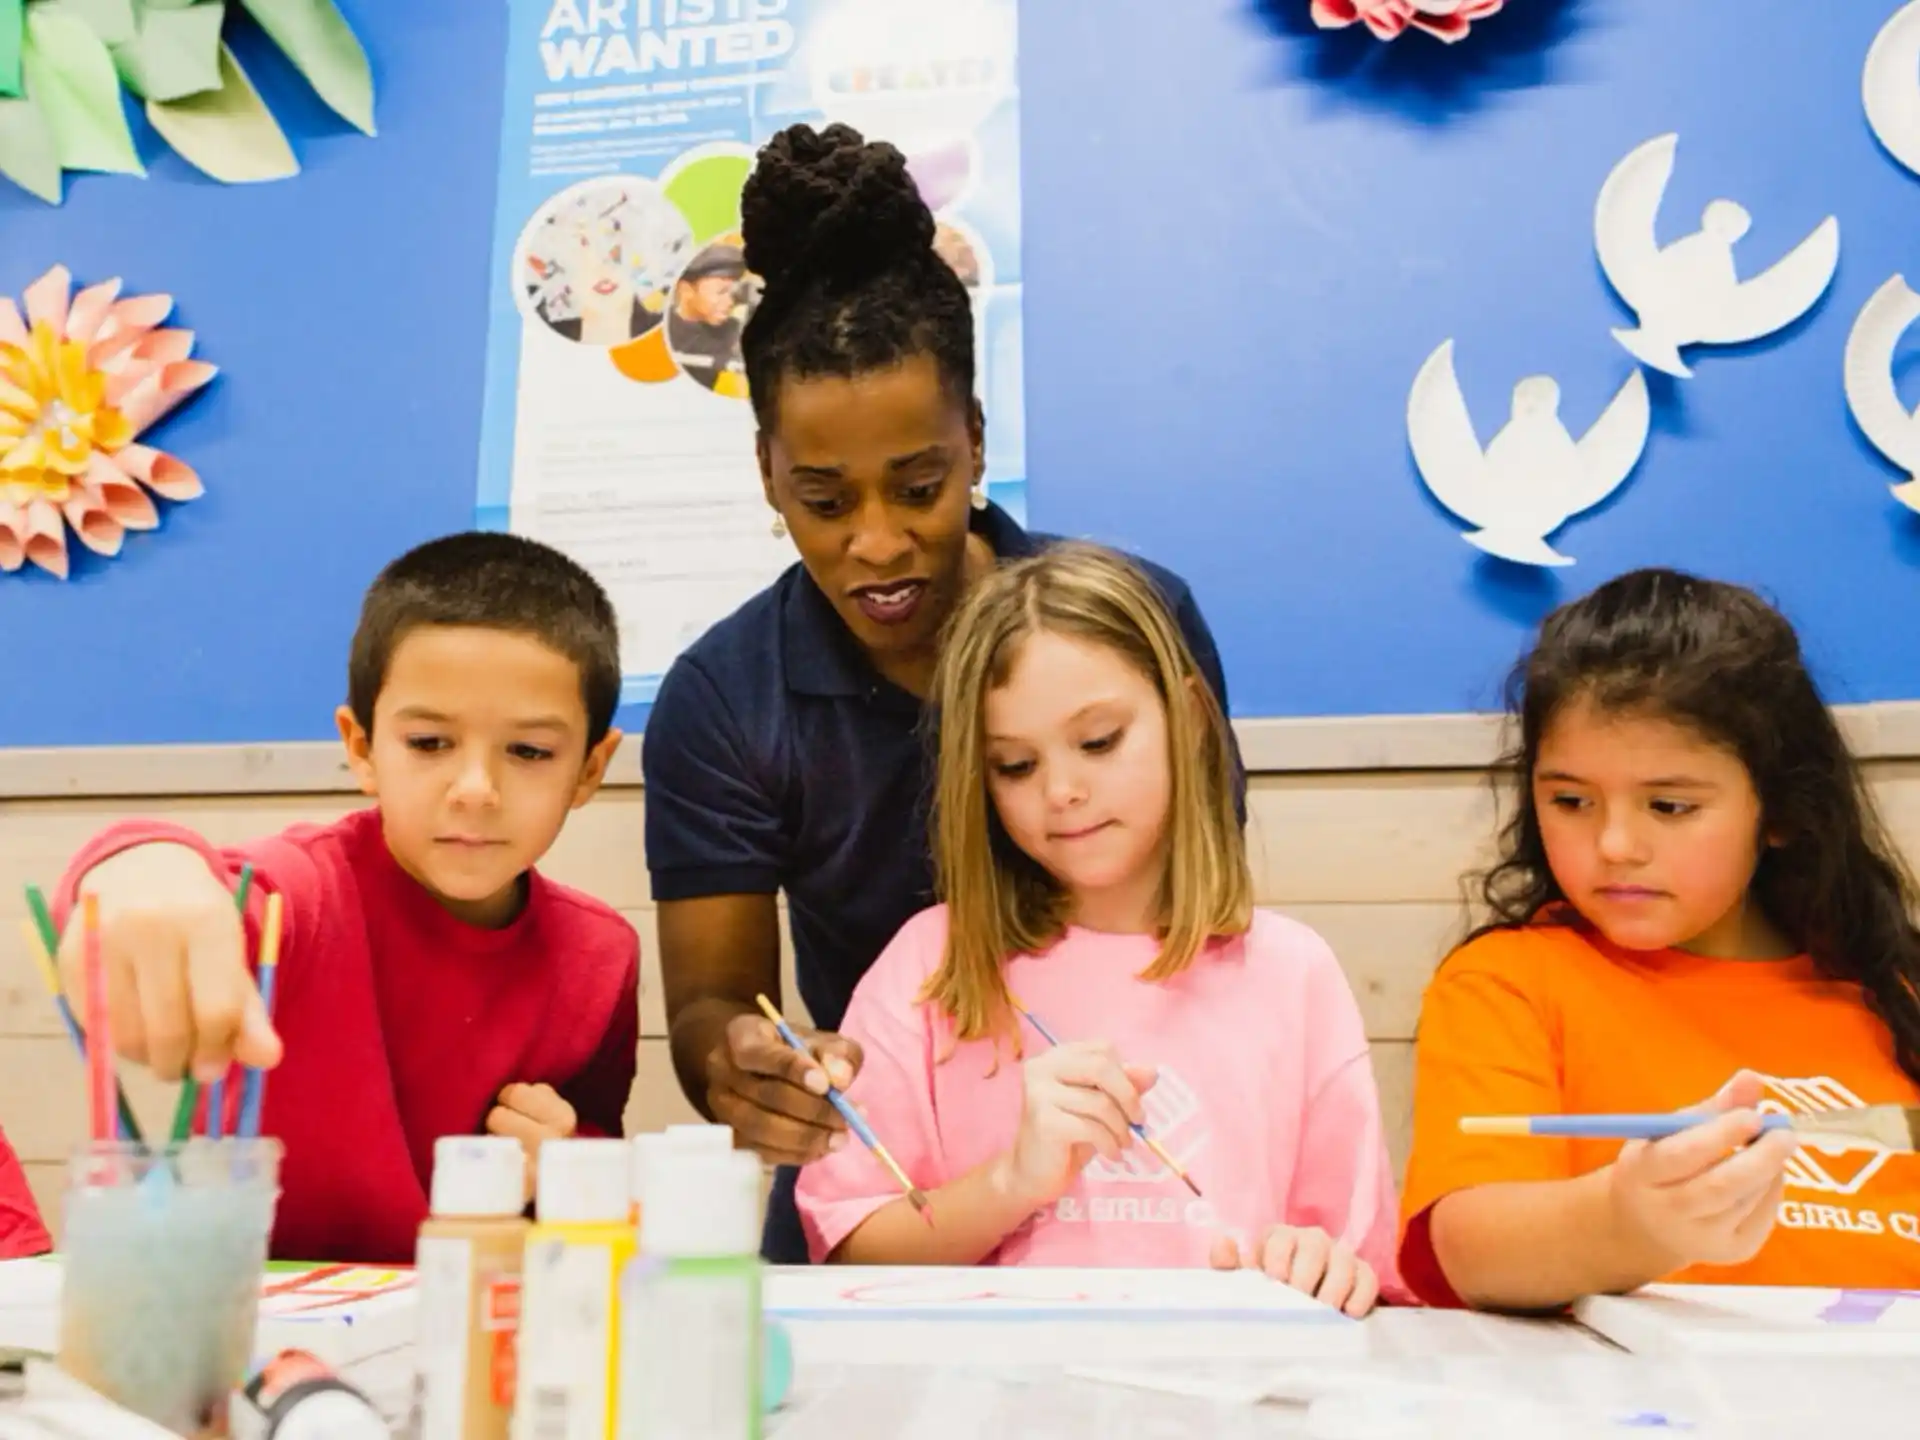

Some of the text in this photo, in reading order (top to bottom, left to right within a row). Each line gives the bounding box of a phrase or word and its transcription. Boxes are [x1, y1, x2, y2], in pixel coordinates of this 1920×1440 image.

[540, 19, 794, 82] WANTED
[1056, 1197, 1083, 1223] &
[1088, 1197, 1178, 1223] GIRLS
[1777, 1201, 1884, 1234] GIRLS
